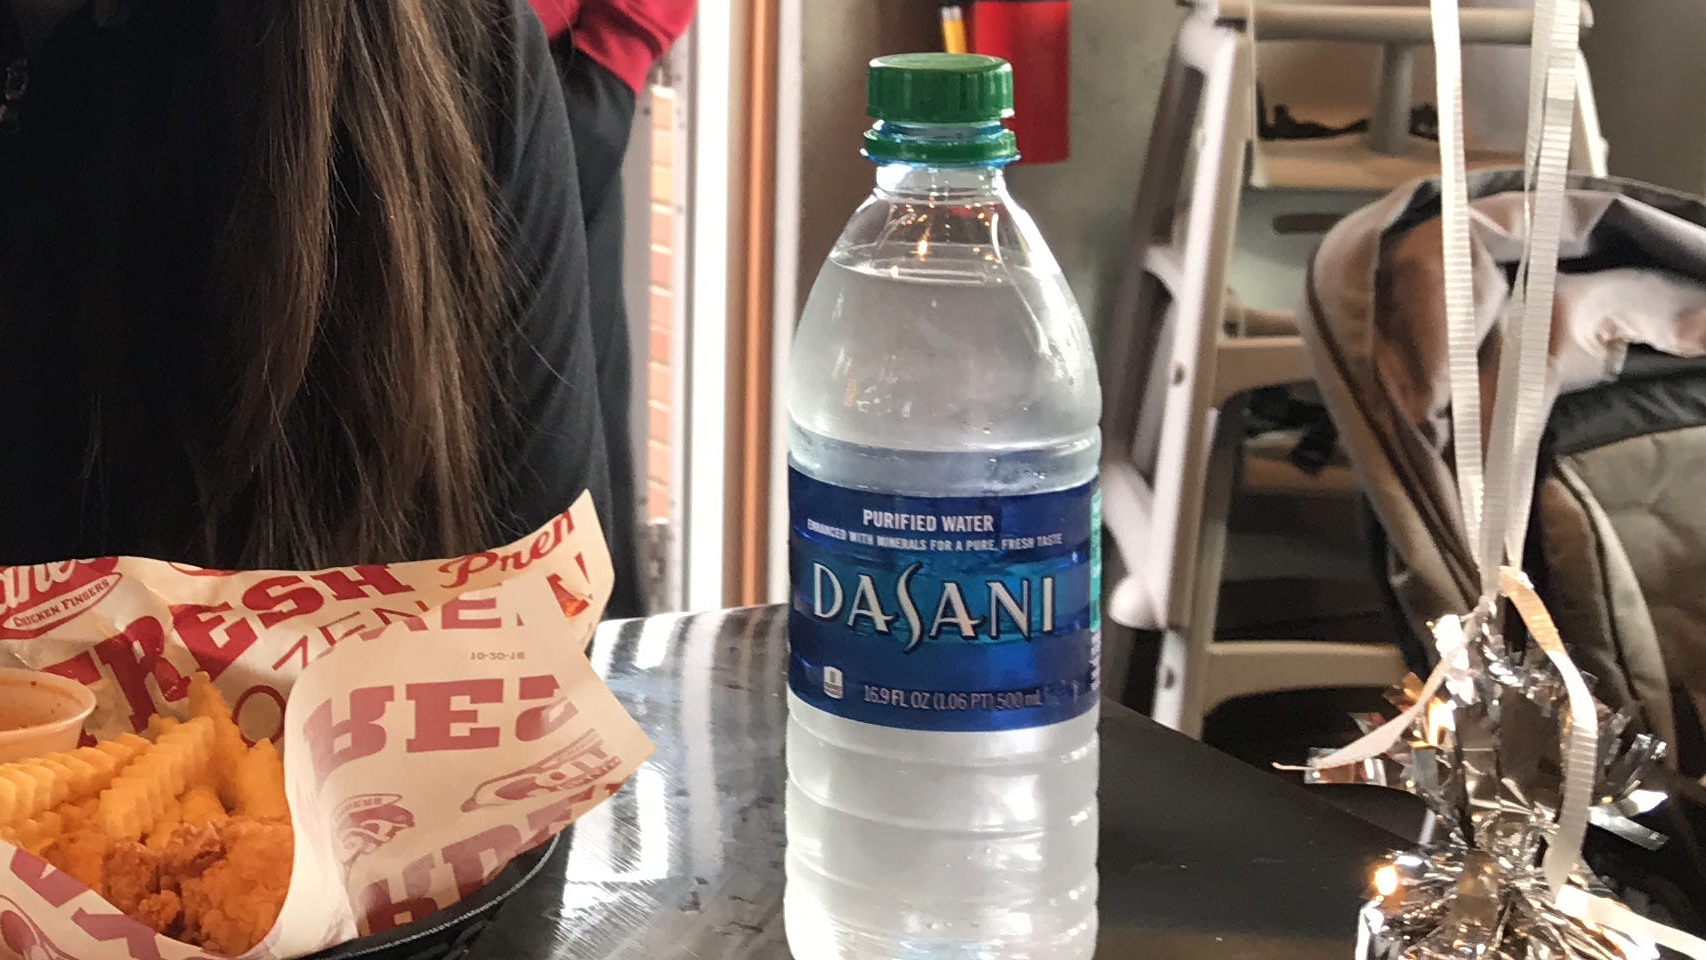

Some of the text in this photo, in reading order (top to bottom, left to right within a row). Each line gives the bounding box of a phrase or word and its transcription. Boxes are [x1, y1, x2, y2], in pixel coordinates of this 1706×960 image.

[862, 509, 994, 532] PURIFIED WATER
[849, 531, 874, 546] WITH
[876, 535, 927, 551] MINERALS
[930, 538, 952, 551] FOR
[955, 539, 964, 551] A
[1001, 537, 1035, 550] FRESH
[811, 561, 1054, 655] DASANI
[891, 690, 908, 707] FL
[910, 691, 930, 710] OZ
